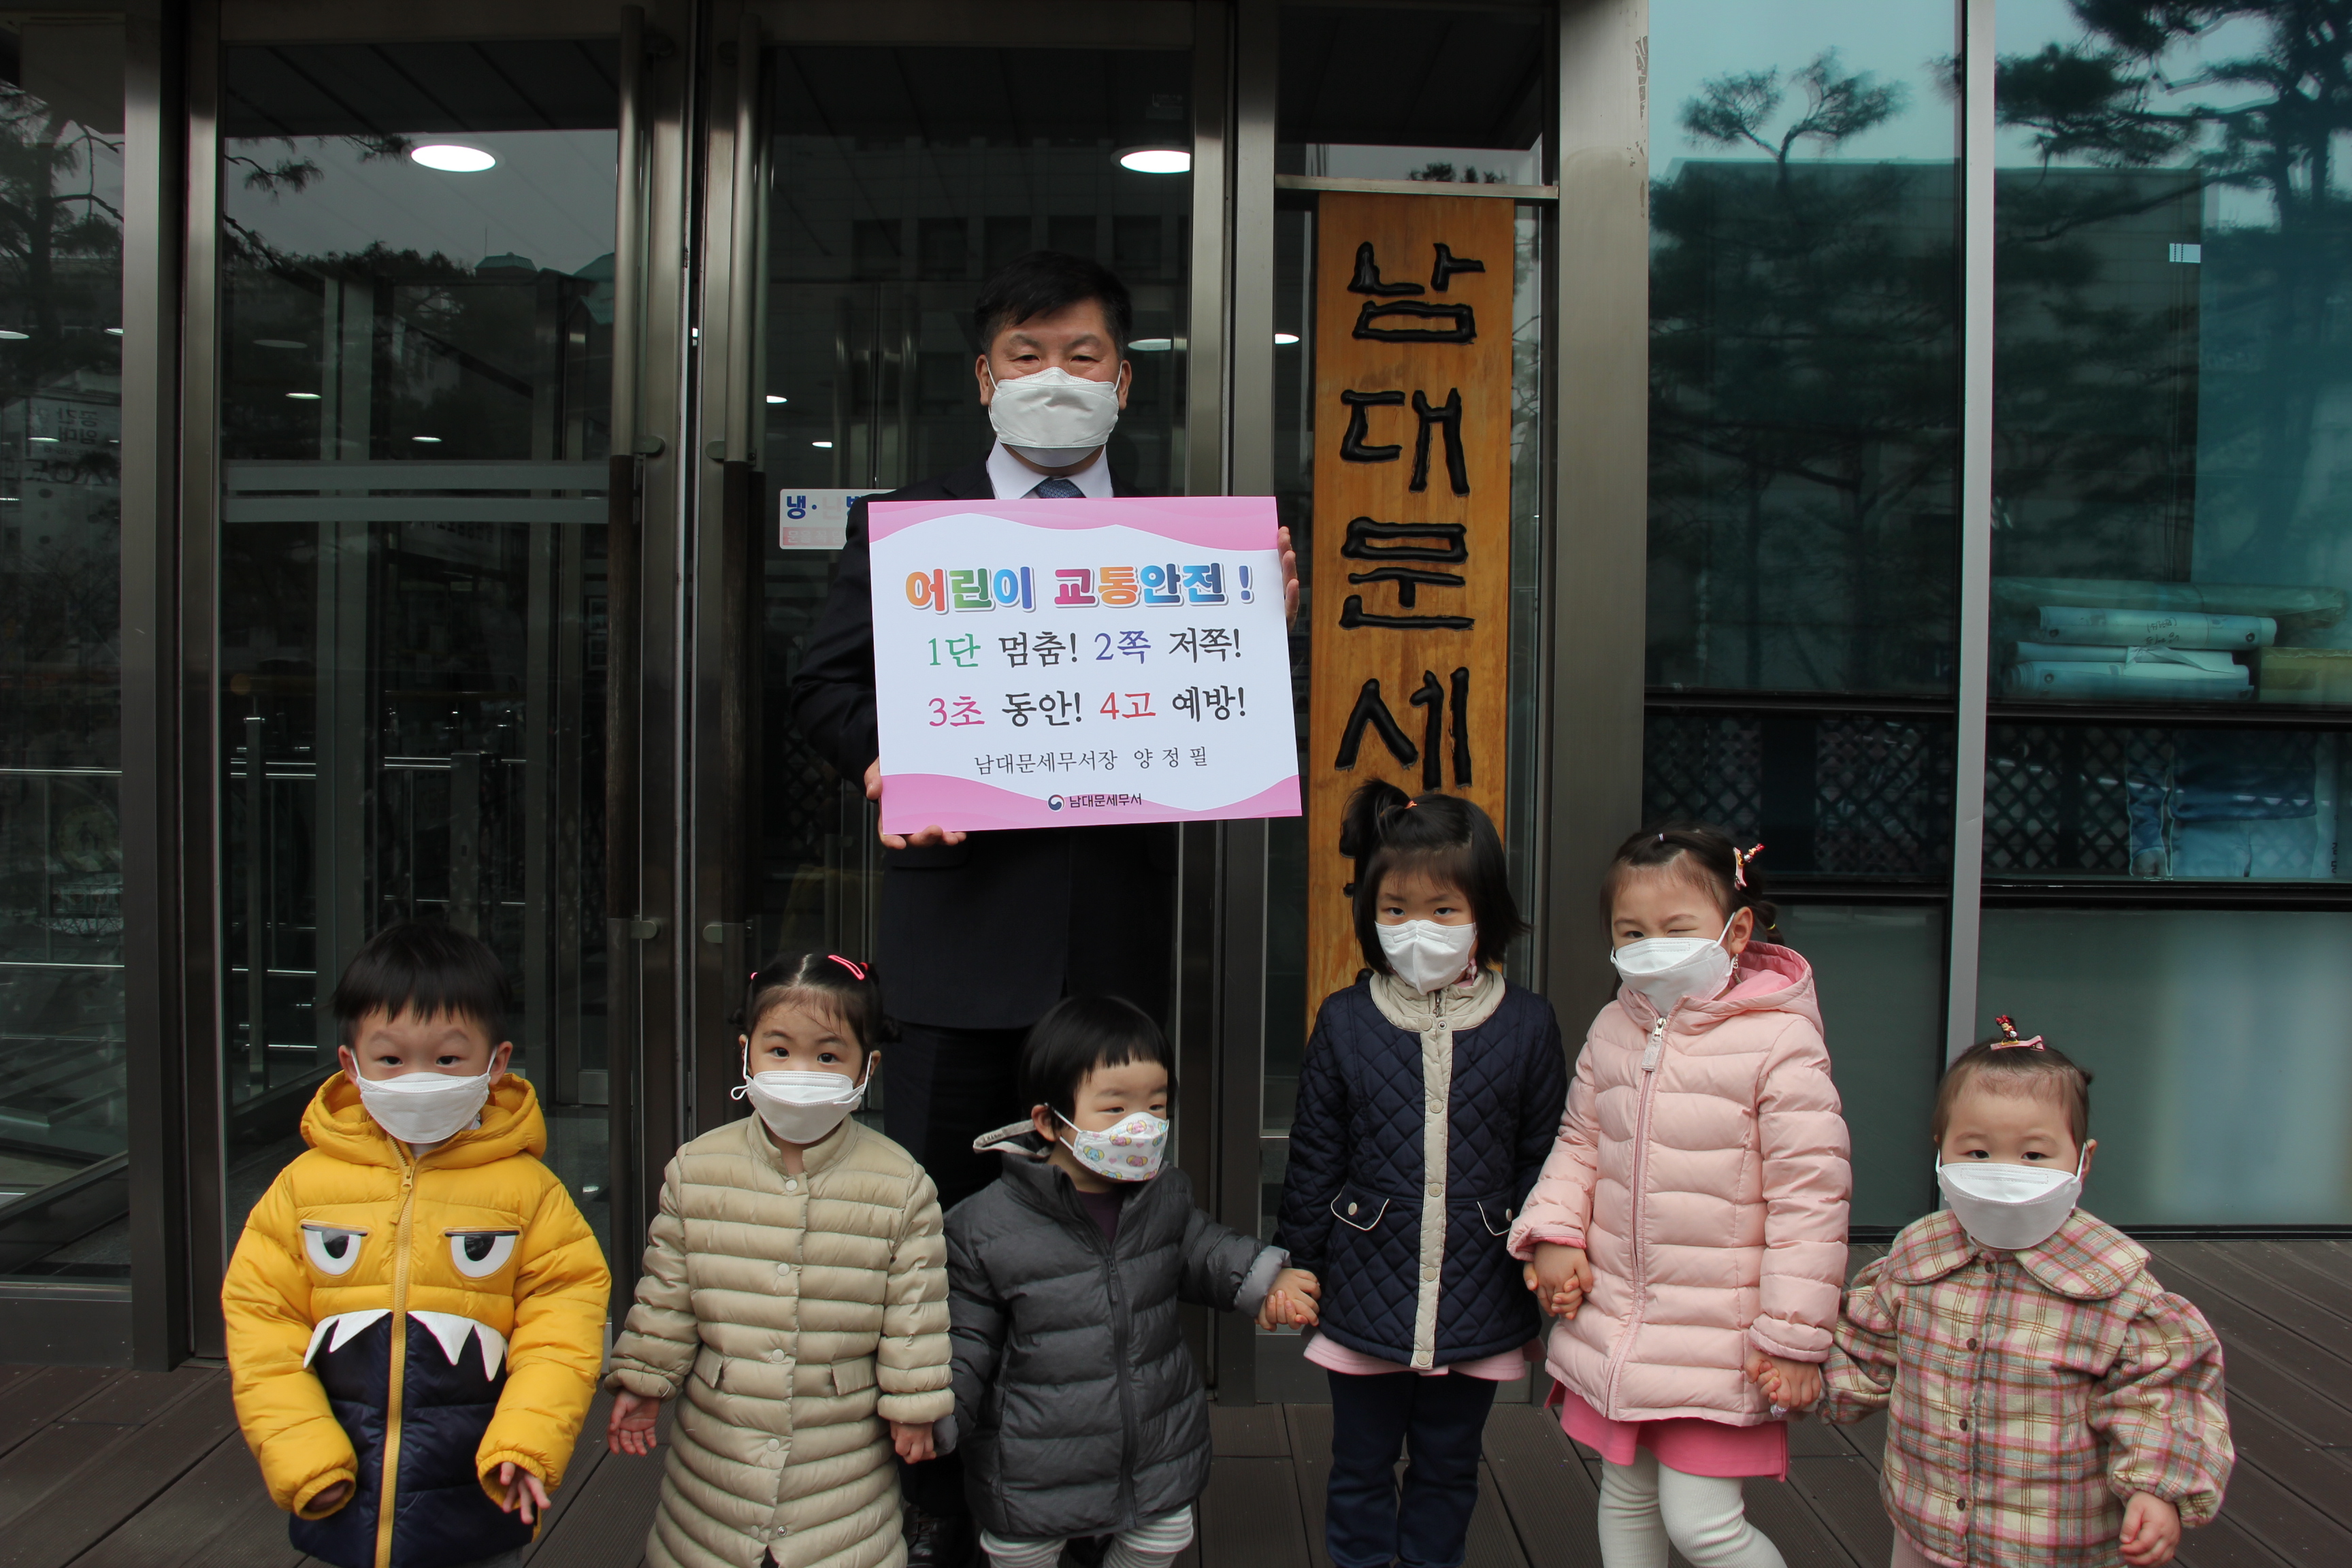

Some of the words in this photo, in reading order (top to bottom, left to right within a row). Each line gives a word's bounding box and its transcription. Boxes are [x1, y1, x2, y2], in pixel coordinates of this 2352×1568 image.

[906, 566, 1035, 614] 어린이
[1054, 563, 1225, 606] 교통안전
[928, 633, 981, 667] 1단
[998, 631, 1077, 668] 멈춤!
[1094, 631, 1152, 664] 2쪽
[1169, 627, 1241, 663] 저쪽!
[928, 696, 985, 727] 3초
[1001, 690, 1082, 727] 동안!
[1100, 691, 1156, 720] 4고
[1172, 685, 1246, 722] 예방!
[974, 749, 1118, 776] 남대문세무서장
[1069, 792, 1143, 808] 남대문세무서
